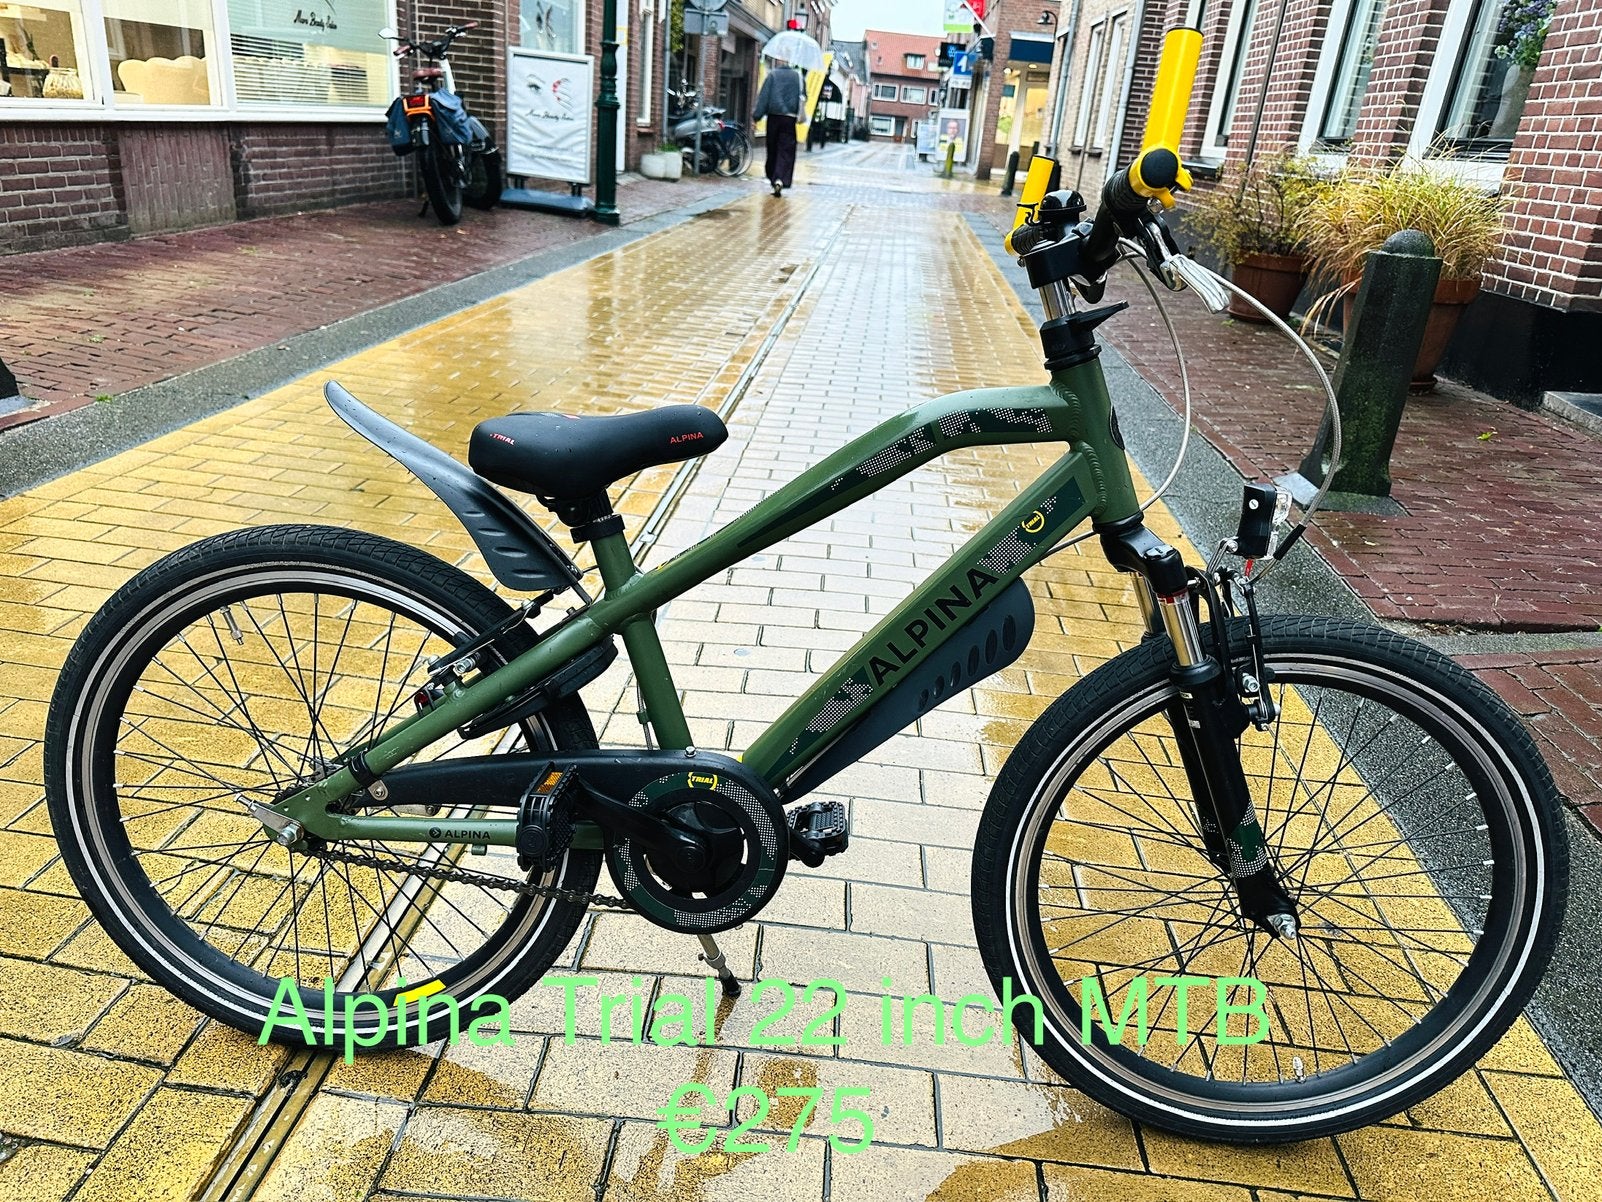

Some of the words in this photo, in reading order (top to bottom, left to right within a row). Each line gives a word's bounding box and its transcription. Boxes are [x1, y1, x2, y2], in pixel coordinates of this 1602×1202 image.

[670, 431, 704, 444] ALPINA
[868, 567, 1000, 688] ALPINA
[691, 775, 714, 784] TRIAL
[444, 829, 491, 840] ALPINA
